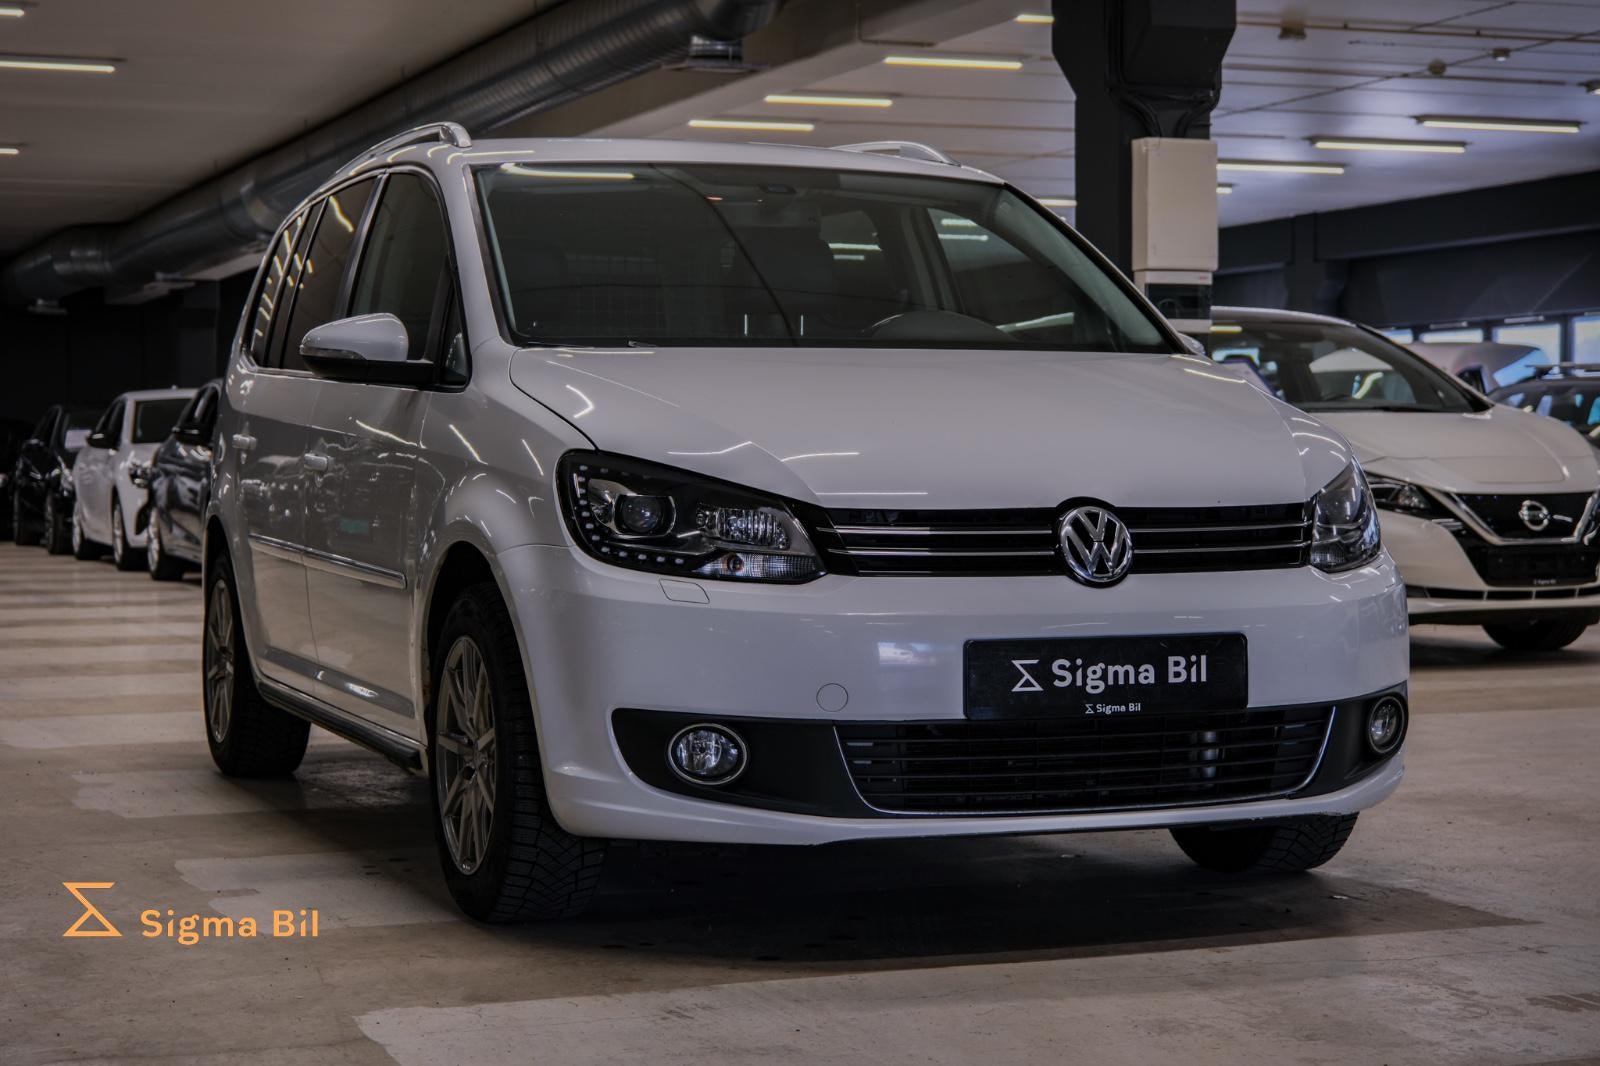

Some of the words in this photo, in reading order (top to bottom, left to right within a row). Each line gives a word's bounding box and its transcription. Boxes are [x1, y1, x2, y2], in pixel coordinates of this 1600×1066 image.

[1052, 658, 1155, 694] Sigma
[1167, 655, 1207, 683] Bil
[1096, 703, 1126, 714] Sigma
[1128, 702, 1141, 711] Bil
